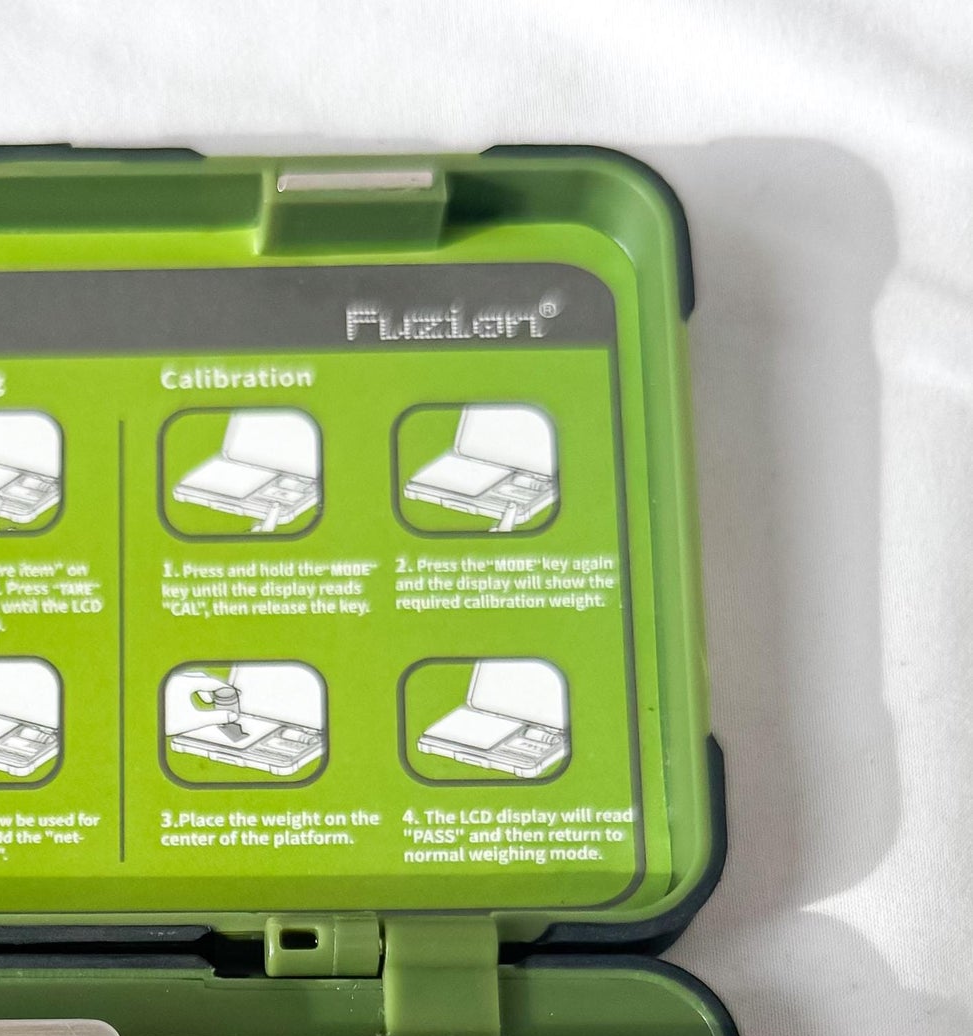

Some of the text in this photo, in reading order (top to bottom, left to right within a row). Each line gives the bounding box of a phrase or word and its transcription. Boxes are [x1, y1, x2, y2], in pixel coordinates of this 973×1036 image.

[161, 366, 313, 391] Calibration
[67, 565, 87, 576] on
[163, 563, 180, 578] 1.
[183, 565, 224, 578] Press
[228, 564, 255, 577] and
[260, 563, 294, 577] hold
[395, 559, 413, 573] 2.
[418, 559, 456, 572] Press
[542, 557, 568, 573] key
[573, 557, 613, 573] again
[6, 582, 48, 595] Press
[163, 582, 362, 599] key until the display reads
[395, 576, 614, 592] and the display will show the
[2, 601, 38, 613] until
[42, 601, 67, 613] the
[72, 601, 102, 613] LCD
[163, 599, 370, 618] "CAL", then release the key.
[396, 594, 605, 612] required calibration weight.
[16, 814, 35, 827] be
[38, 814, 74, 826] used
[78, 813, 100, 826] for
[229, 812, 256, 826] the
[262, 812, 320, 829] weight
[325, 815, 346, 826] on
[351, 811, 379, 826] the
[403, 808, 633, 826] 4. The LCD display will read
[16, 831, 41, 844] the
[161, 830, 353, 847] center of the platform.
[404, 828, 623, 843] "PASS" and then return to
[404, 846, 602, 864] normal weighing mode.
